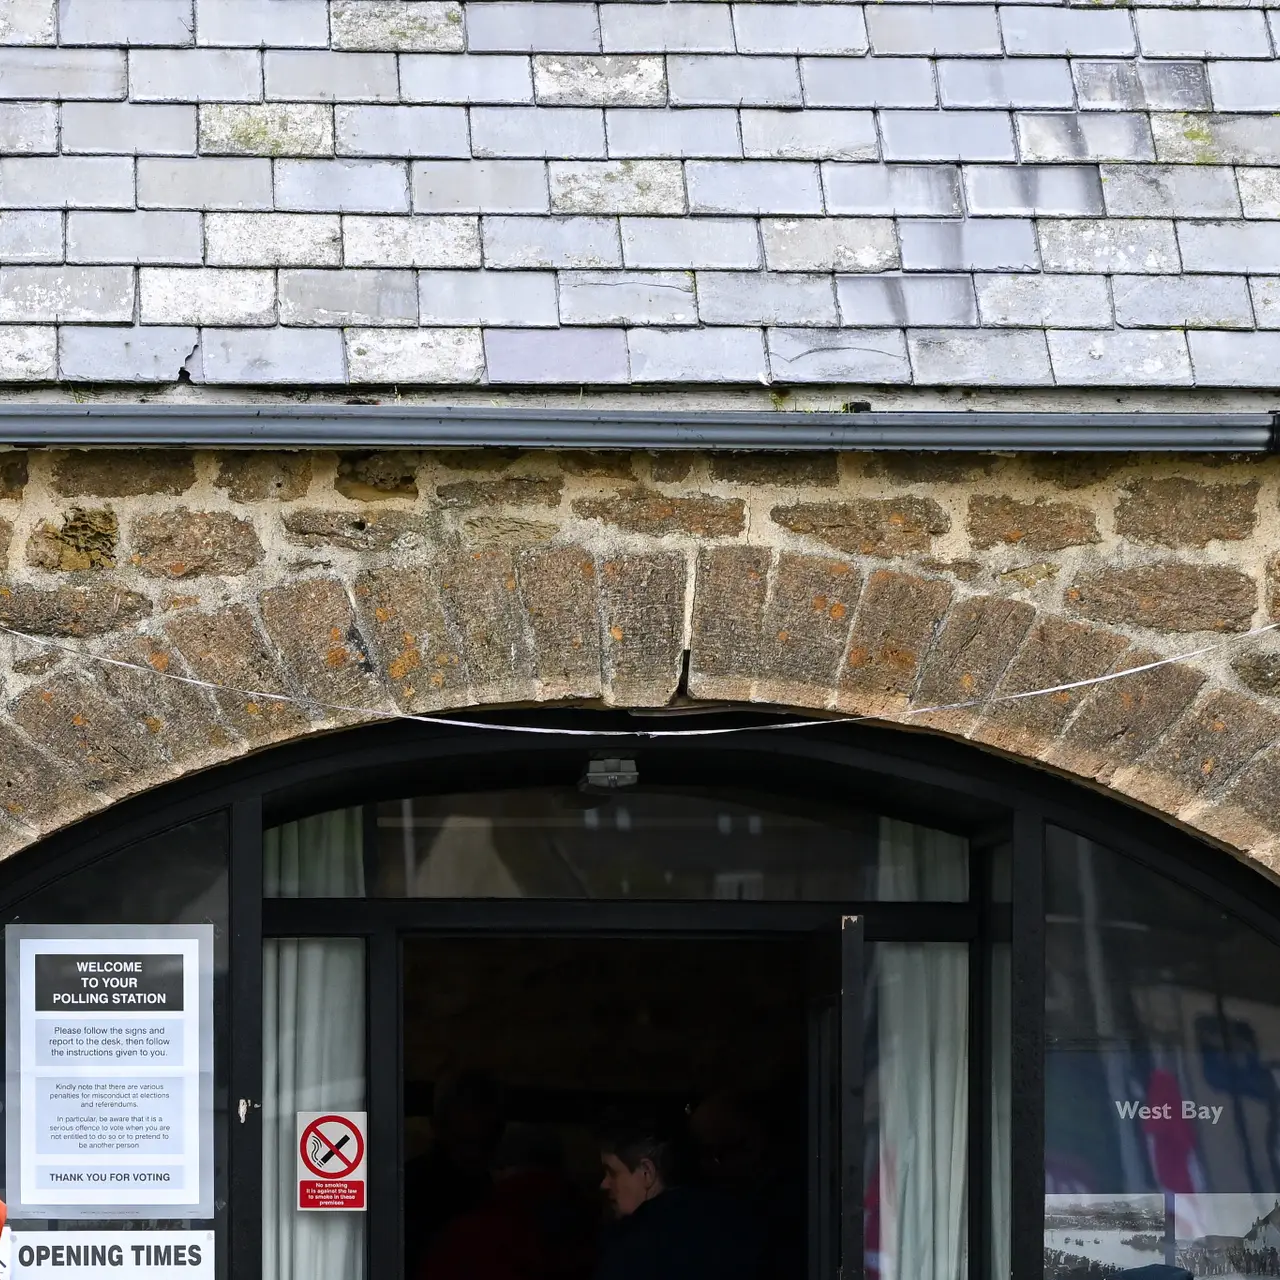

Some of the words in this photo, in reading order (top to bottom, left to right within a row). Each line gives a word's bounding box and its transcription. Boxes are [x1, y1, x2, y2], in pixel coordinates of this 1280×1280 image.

[76, 961, 143, 973] WELCOME
[80, 977, 99, 989] TO
[101, 977, 138, 989] YOUR
[52, 992, 109, 1005] POLLING
[111, 992, 167, 1005] STATION
[54, 1026, 82, 1035] Please
[83, 1026, 108, 1035] follow
[109, 1026, 124, 1035] the
[124, 1027, 148, 1037] signs
[148, 1026, 165, 1035] and
[48, 1037, 74, 1047] report
[75, 1037, 85, 1046] to
[85, 1037, 100, 1046] the
[100, 1037, 124, 1046] desk,
[125, 1037, 145, 1046] then
[145, 1037, 171, 1046] follow
[50, 1048, 65, 1057] the
[66, 1048, 114, 1057] instructions
[115, 1048, 138, 1059] given
[139, 1048, 149, 1057] to
[149, 1049, 168, 1058] you.
[55, 1083, 77, 1092] Kindly
[77, 1083, 93, 1091] note
[94, 1083, 108, 1091] that
[49, 1092, 80, 1101] penalties
[80, 1092, 91, 1100] for
[91, 1092, 131, 1100] misconduct
[80, 1100, 94, 1108] and
[95, 1100, 139, 1108] referendums.
[1115, 1101, 1172, 1119] West
[1181, 1101, 1223, 1124] Bay
[56, 1115, 64, 1123] In
[65, 1115, 98, 1124] particular,
[98, 1115, 108, 1123] be
[130, 1115, 144, 1123] that
[49, 1124, 74, 1132] serious
[74, 1124, 101, 1132] offence
[101, 1124, 109, 1132] to
[125, 1124, 144, 1132] when
[144, 1125, 158, 1133] you
[134, 1133, 161, 1141] pretend
[78, 1141, 88, 1149] be
[88, 1141, 115, 1149] another
[115, 1142, 140, 1150] person
[49, 1173, 84, 1182] THANK
[85, 1172, 107, 1182] YOU
[109, 1172, 131, 1182] FOR
[132, 1172, 171, 1182] VOTING
[19, 1245, 123, 1267] OPENING
[131, 1245, 201, 1266] TIMES
